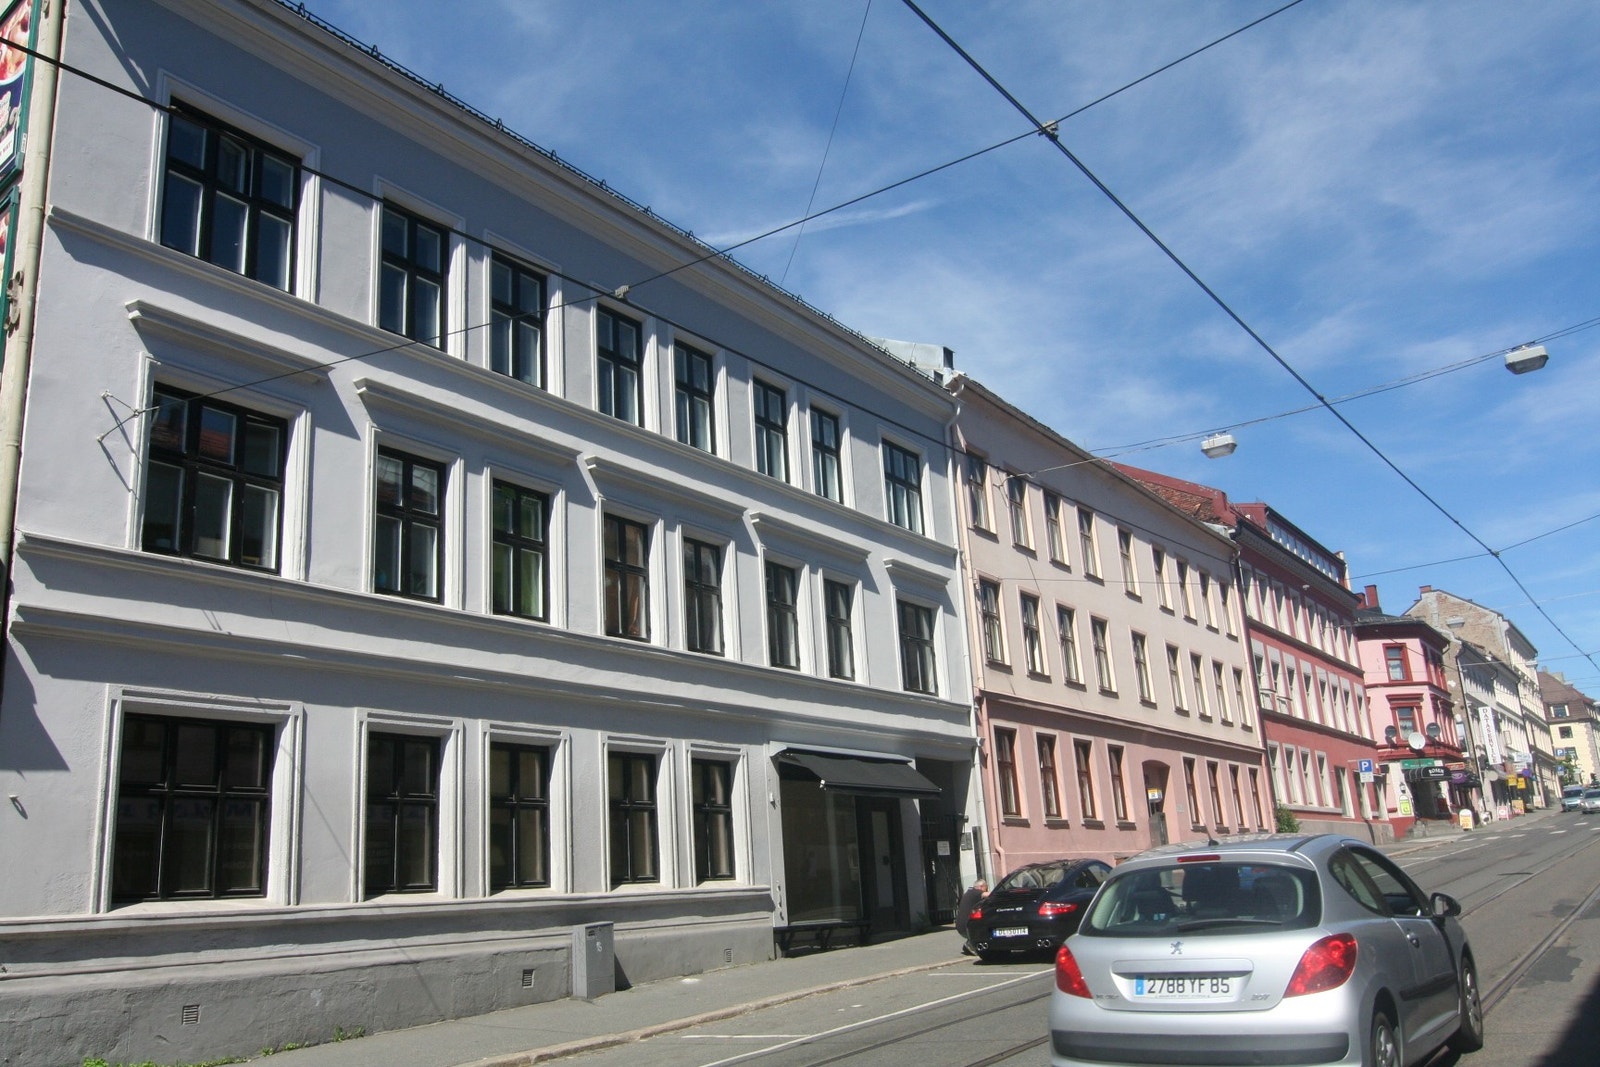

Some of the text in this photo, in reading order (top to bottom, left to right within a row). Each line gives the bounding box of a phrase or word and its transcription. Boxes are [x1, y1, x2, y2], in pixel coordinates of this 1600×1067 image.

[1483, 709, 1498, 763] DATASERVICE
[1361, 761, 1369, 771] P
[1147, 977, 1230, 994] 2788 YF 85
